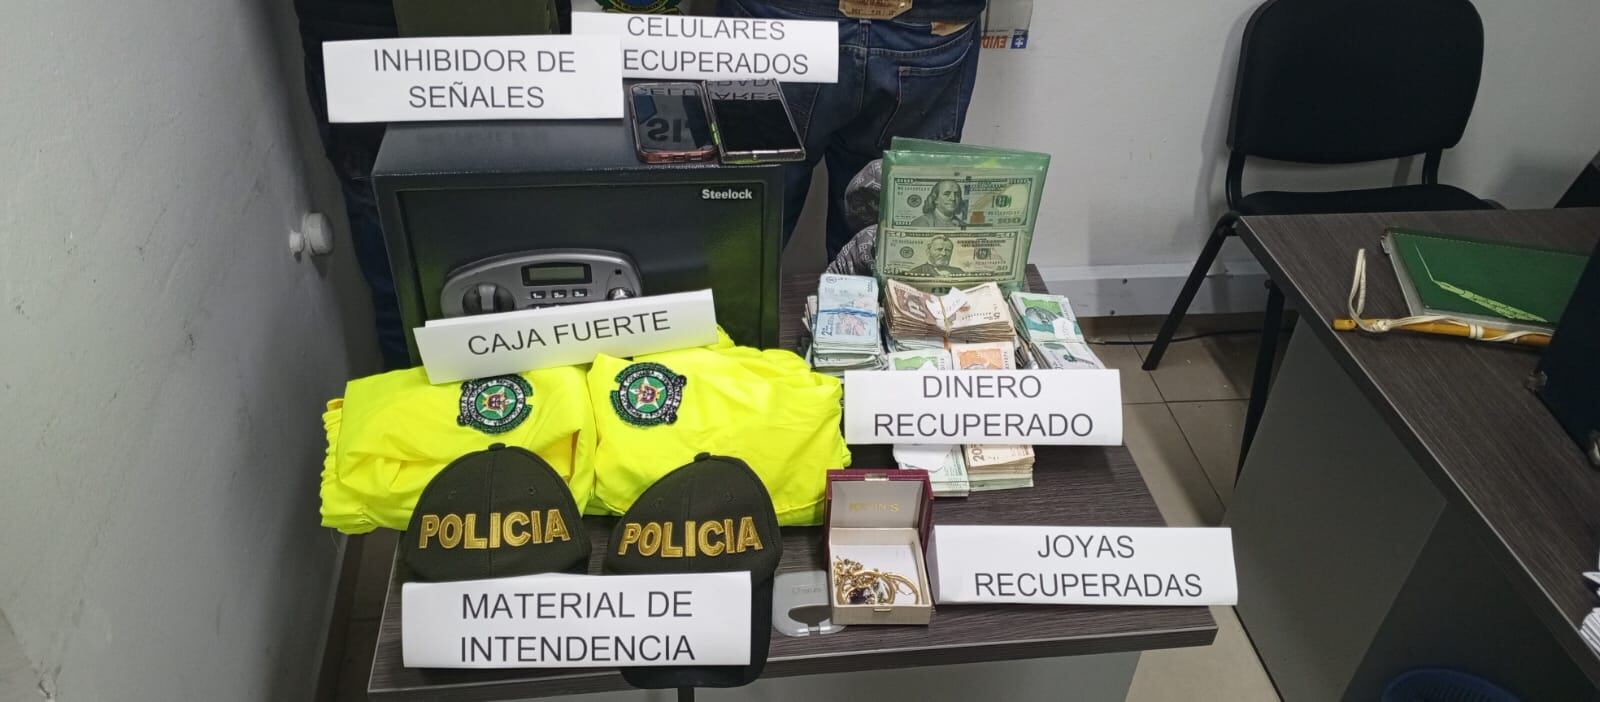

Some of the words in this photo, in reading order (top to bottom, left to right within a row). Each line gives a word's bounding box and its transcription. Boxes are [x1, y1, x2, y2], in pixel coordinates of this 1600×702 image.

[627, 16, 786, 40] CELULARES
[982, 35, 1008, 48] EVID
[373, 49, 527, 72] INHIBIDOR
[537, 50, 576, 72] DE
[623, 49, 809, 75] ECUPERADOS
[408, 82, 545, 108] SEÑALES
[701, 188, 753, 200] Steelock
[467, 330, 547, 356] CAJA
[552, 309, 672, 345] FUERTE
[922, 375, 1042, 398] DINERO
[873, 413, 1094, 437] RECUPERADO
[418, 508, 571, 550] POLICIA
[617, 516, 764, 559] POLICIA
[1037, 534, 1136, 559] JOYAS
[974, 572, 1204, 597] RECUPERADAS
[461, 592, 636, 620] MATERIAL
[647, 590, 694, 618] DE
[460, 635, 696, 663] INTENDENCIA
